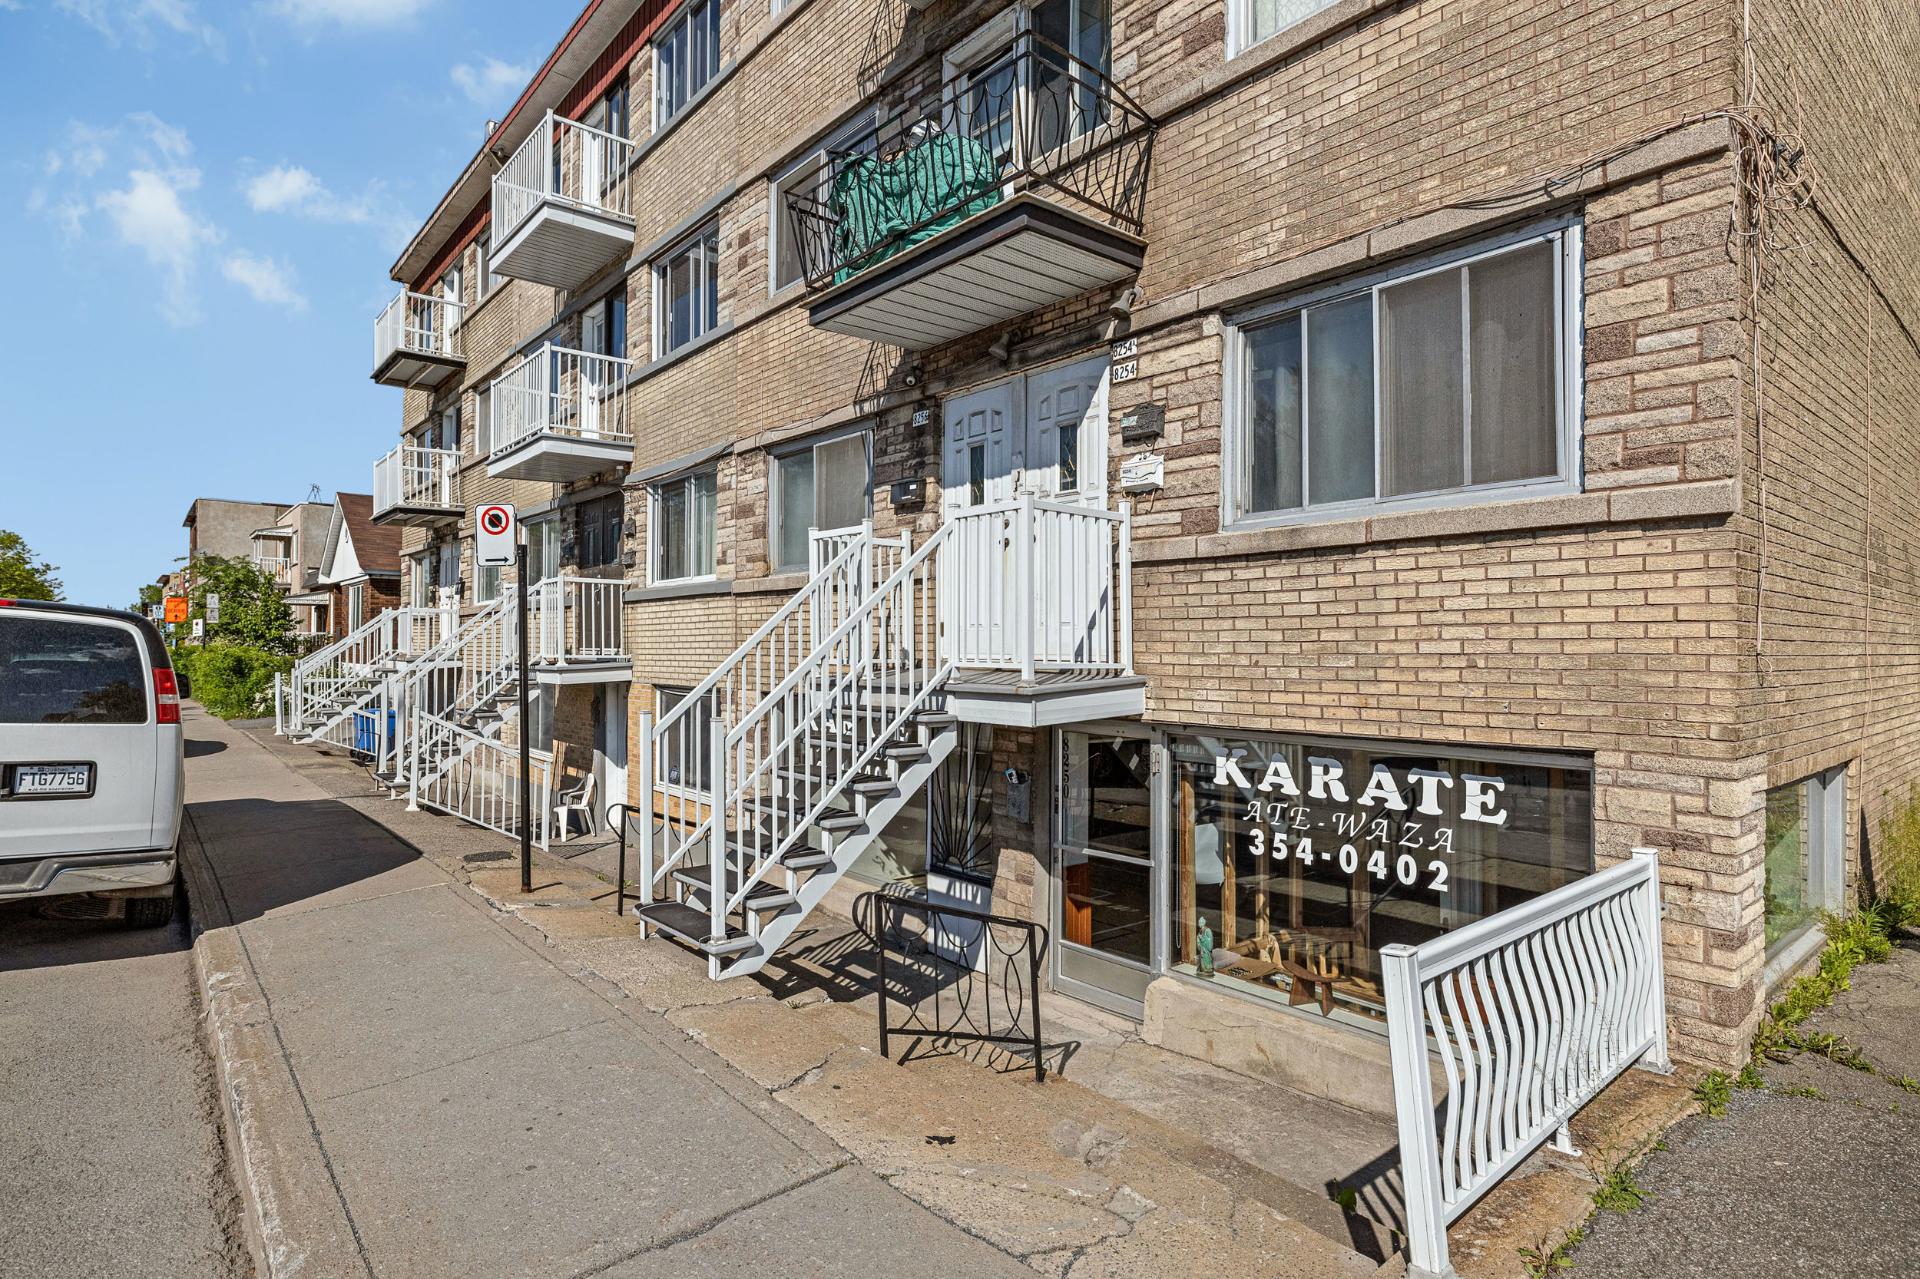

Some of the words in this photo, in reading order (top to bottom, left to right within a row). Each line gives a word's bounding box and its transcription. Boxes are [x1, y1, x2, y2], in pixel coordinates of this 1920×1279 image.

[1114, 363, 1135, 380] 8254
[19, 772, 85, 786] FTG7756
[1213, 747, 1507, 825] KARATE
[1243, 801, 1455, 853] ATE-WAZA
[1249, 829, 1449, 892] 354-0402
